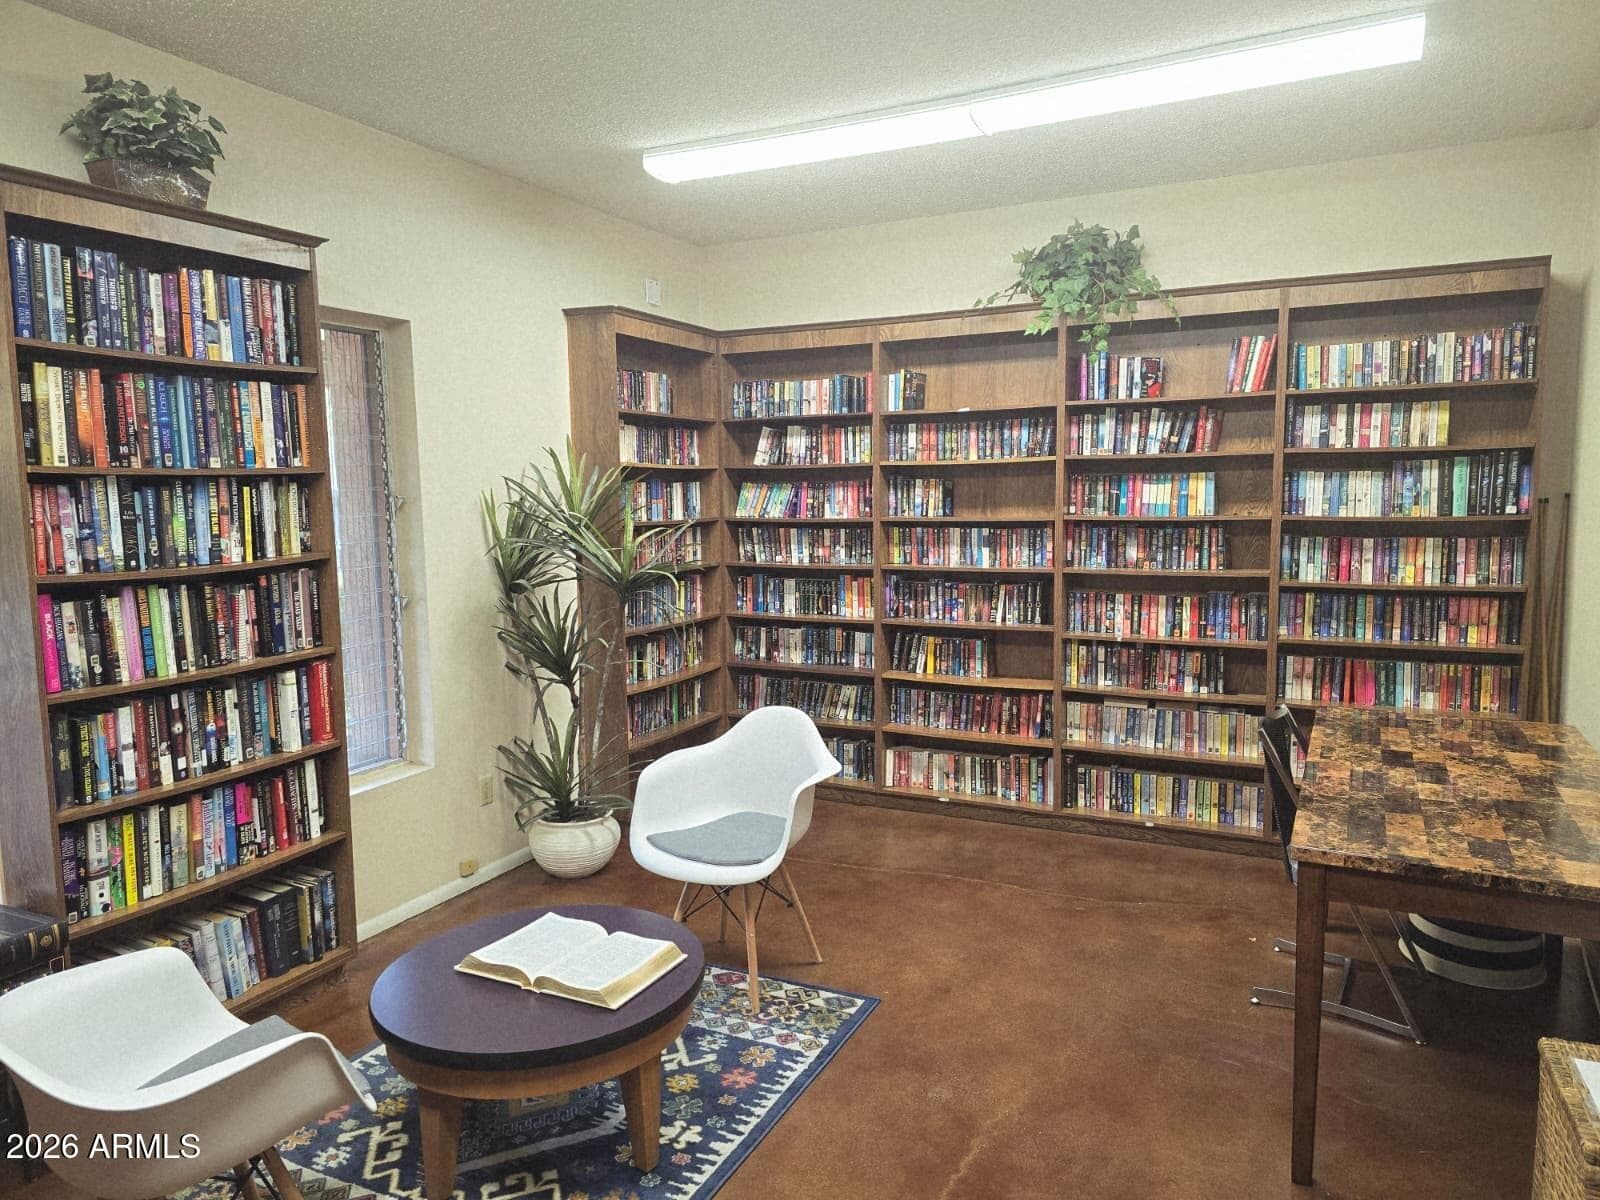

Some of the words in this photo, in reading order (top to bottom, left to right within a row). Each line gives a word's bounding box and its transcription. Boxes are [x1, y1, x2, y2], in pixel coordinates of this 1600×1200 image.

[17, 266, 29, 304] BALDACCI
[108, 278, 118, 310] THUNDER
[65, 285, 73, 314] MOUNTAIN
[79, 371, 87, 390] JAMES
[115, 386, 123, 406] JAMES
[117, 407, 127, 444] PATTERSON
[198, 434, 206, 454] SORRY
[209, 482, 217, 497] LISA
[176, 498, 185, 522] CUSSLER
[210, 498, 220, 535] SCOTTOLINE
[178, 526, 187, 557] MIRAGE
[44, 612, 53, 641] BLACK
[55, 618, 65, 641] HIGGINS
[217, 620, 225, 636] DEAD
[106, 639, 114, 661] WAVE
[288, 782, 298, 810] GRAFTON
